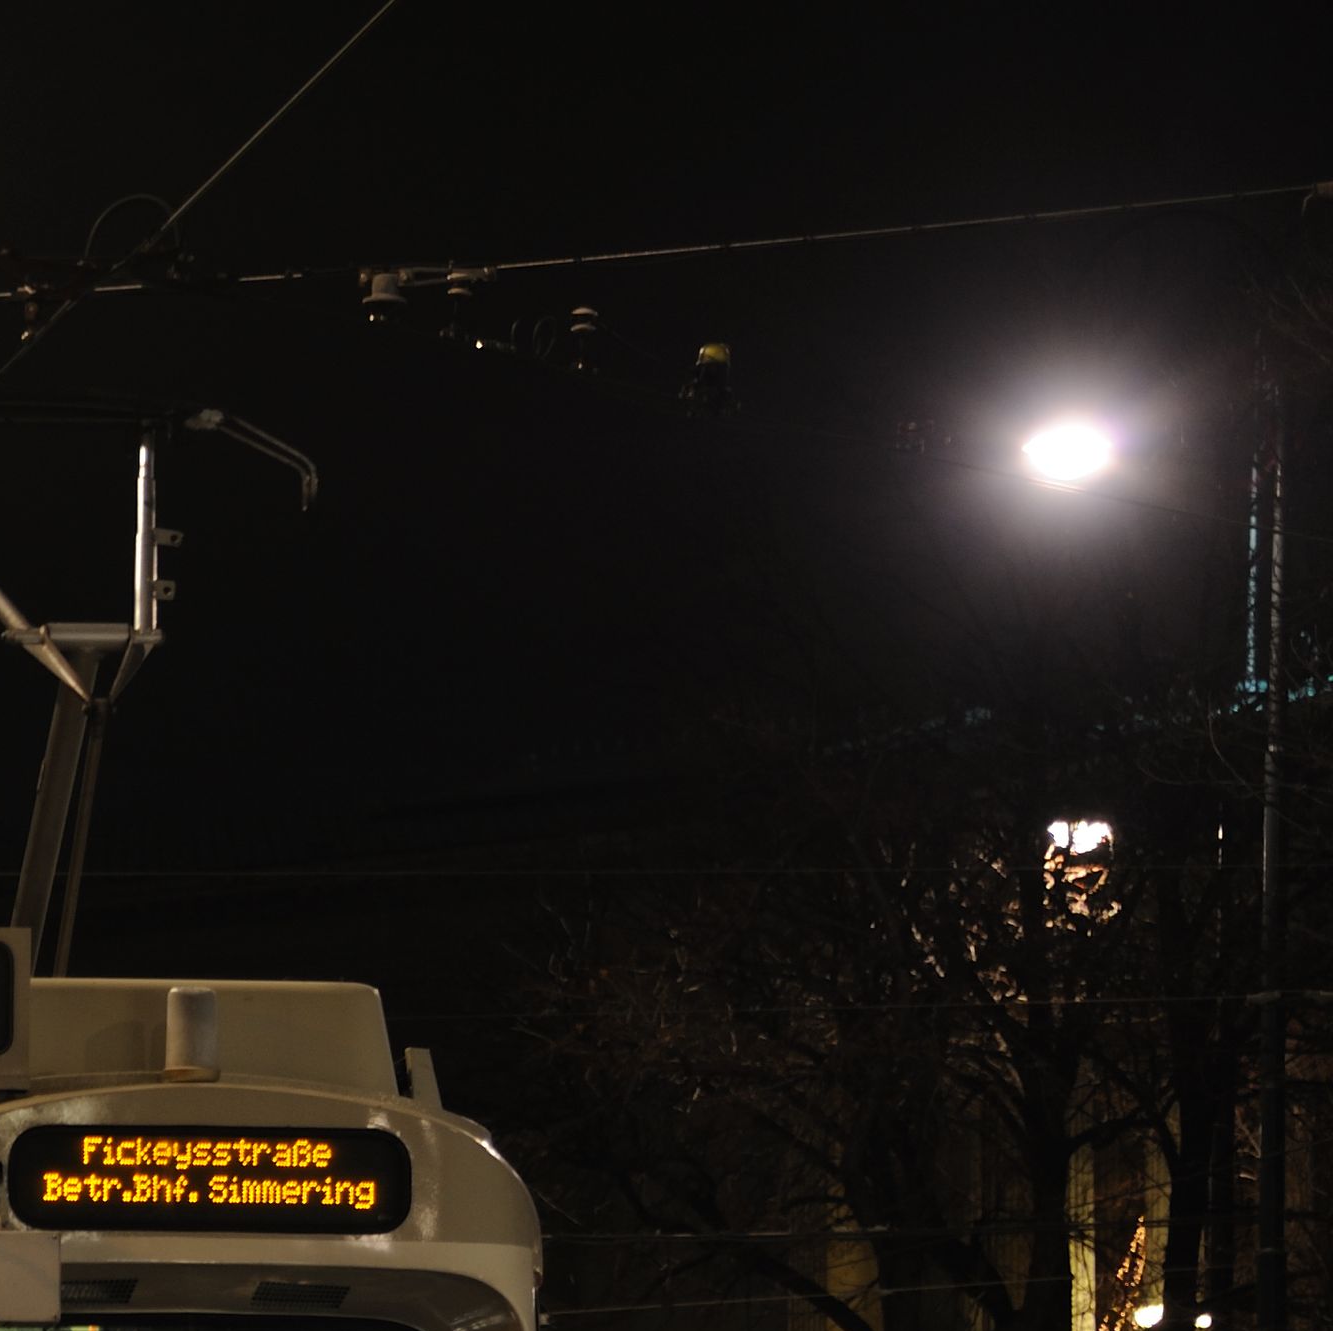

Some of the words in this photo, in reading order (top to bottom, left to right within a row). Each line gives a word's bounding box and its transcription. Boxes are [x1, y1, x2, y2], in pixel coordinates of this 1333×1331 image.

[82, 1134, 332, 1170] Fickeysstraße
[42, 1172, 200, 1204] Betr.Bhf.
[207, 1174, 377, 1211] Simmering
